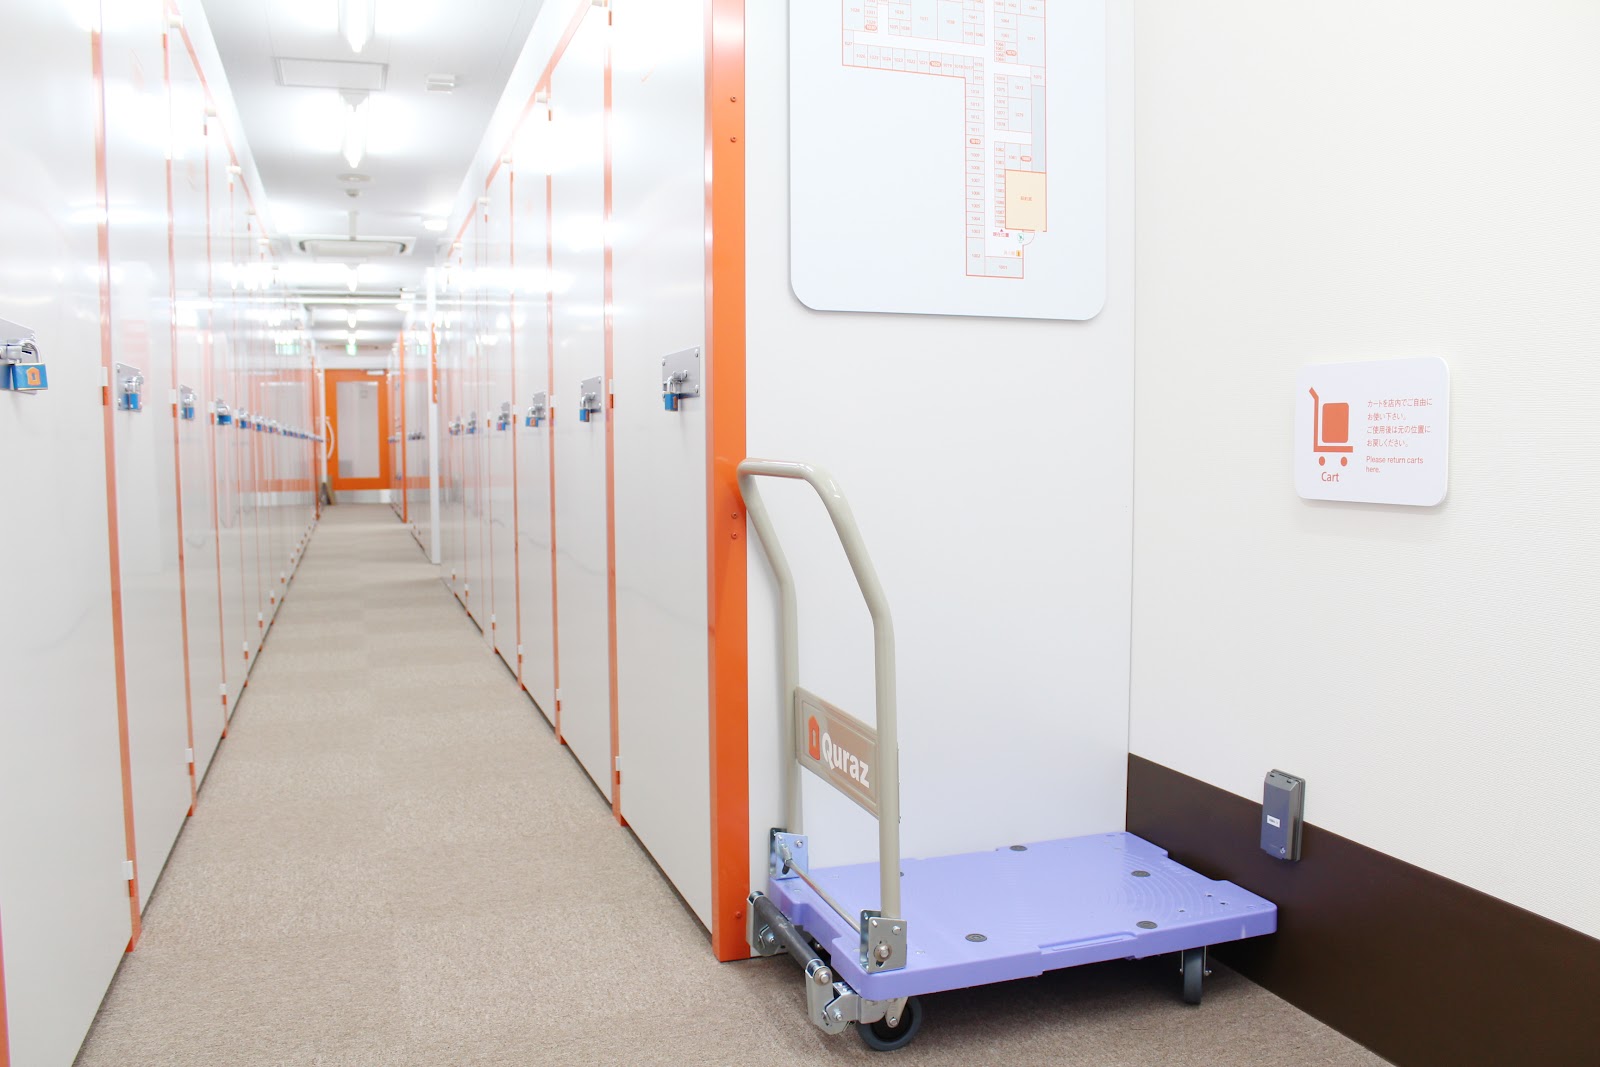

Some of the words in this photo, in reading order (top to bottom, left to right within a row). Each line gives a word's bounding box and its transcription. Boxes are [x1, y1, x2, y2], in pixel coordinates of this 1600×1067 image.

[1368, 398, 1432, 408] カートを店内でご自由に
[1368, 412, 1406, 421] お使い下さい。
[1366, 425, 1430, 434] ご使用後は元の位置に
[1366, 438, 1408, 447] お戻しください。
[1322, 472, 1340, 482] Cart
[822, 732, 869, 788] Quraz
